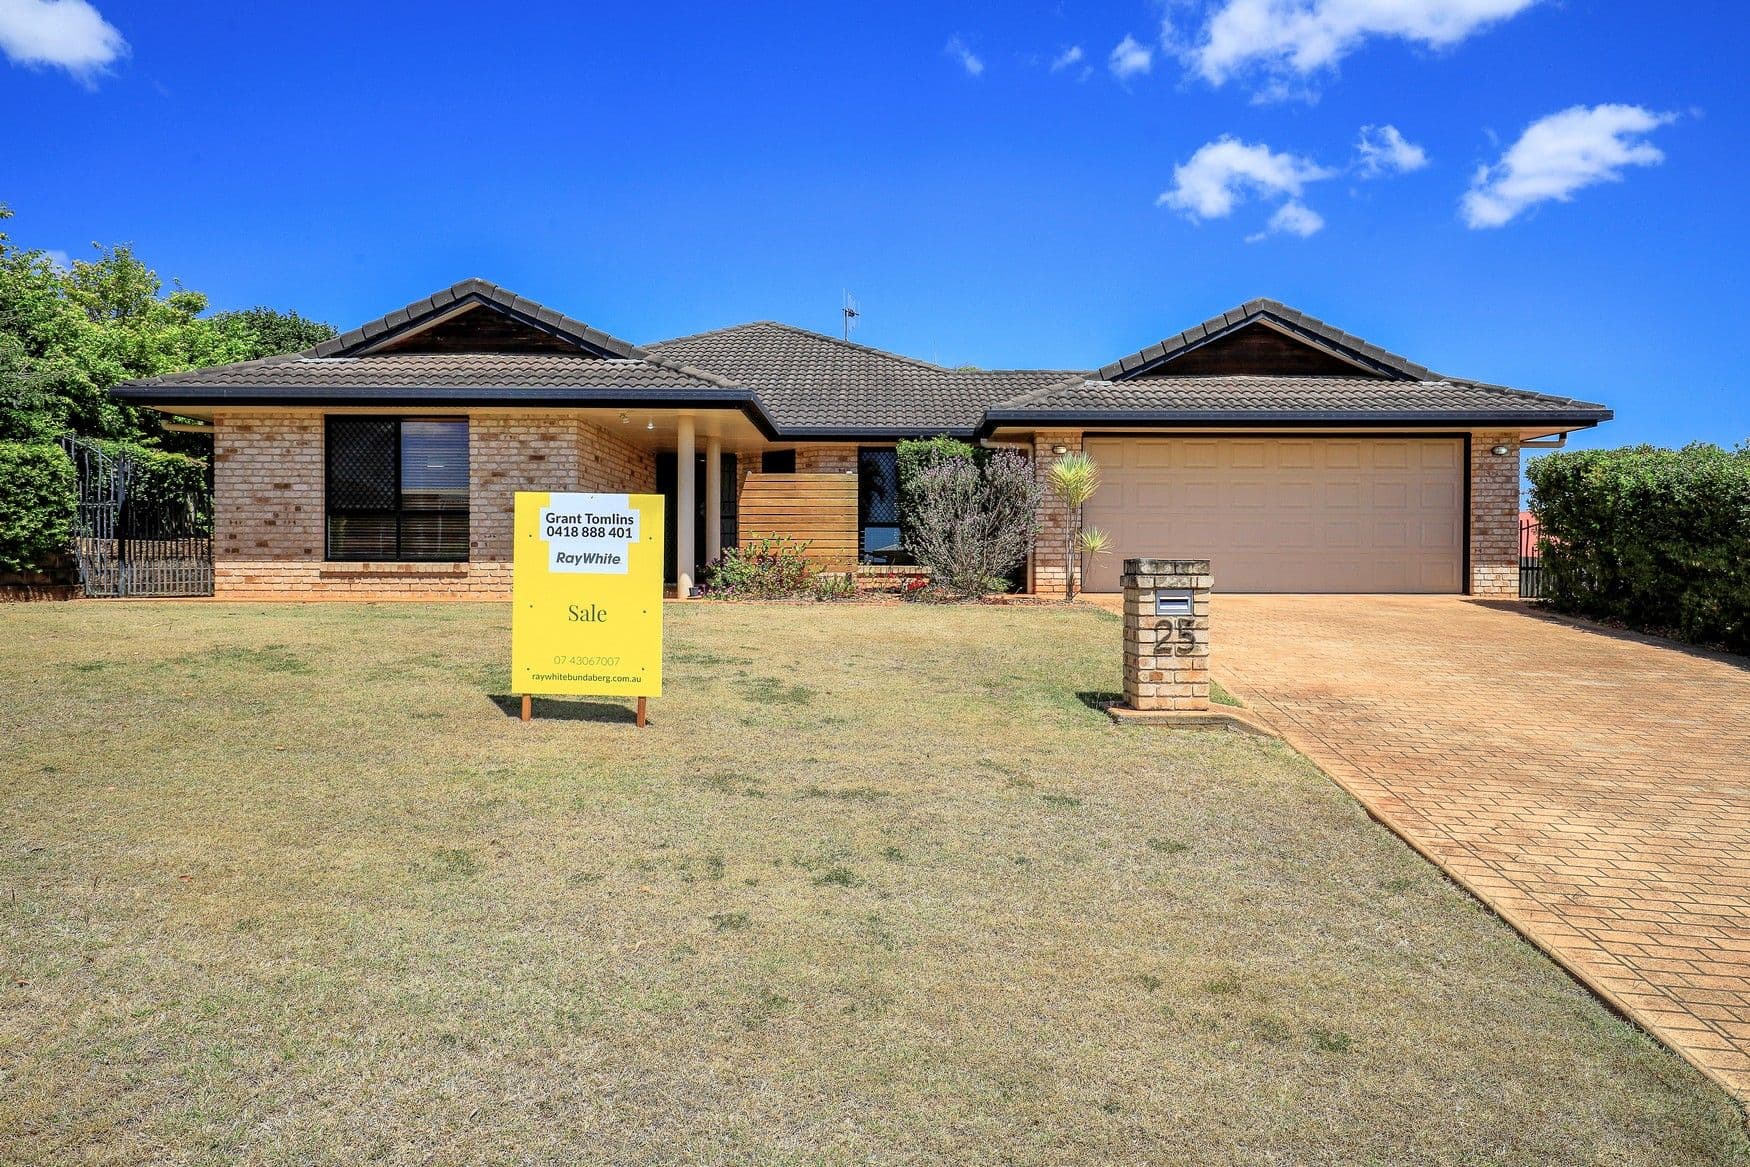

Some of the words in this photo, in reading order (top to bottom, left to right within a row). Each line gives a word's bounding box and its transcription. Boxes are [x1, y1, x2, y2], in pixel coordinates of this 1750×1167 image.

[546, 512, 582, 524] Grant
[585, 513, 634, 525] Tomlins
[546, 525, 579, 538] 0418
[581, 526, 605, 538] 888
[608, 527, 633, 538] 401
[556, 552, 621, 566] RayWhite
[568, 604, 607, 622] Sale
[1153, 619, 1195, 655] 25
[553, 656, 567, 665] 07
[569, 656, 620, 666] 43067007
[532, 673, 642, 684] raywhitebundaberg.com.au
